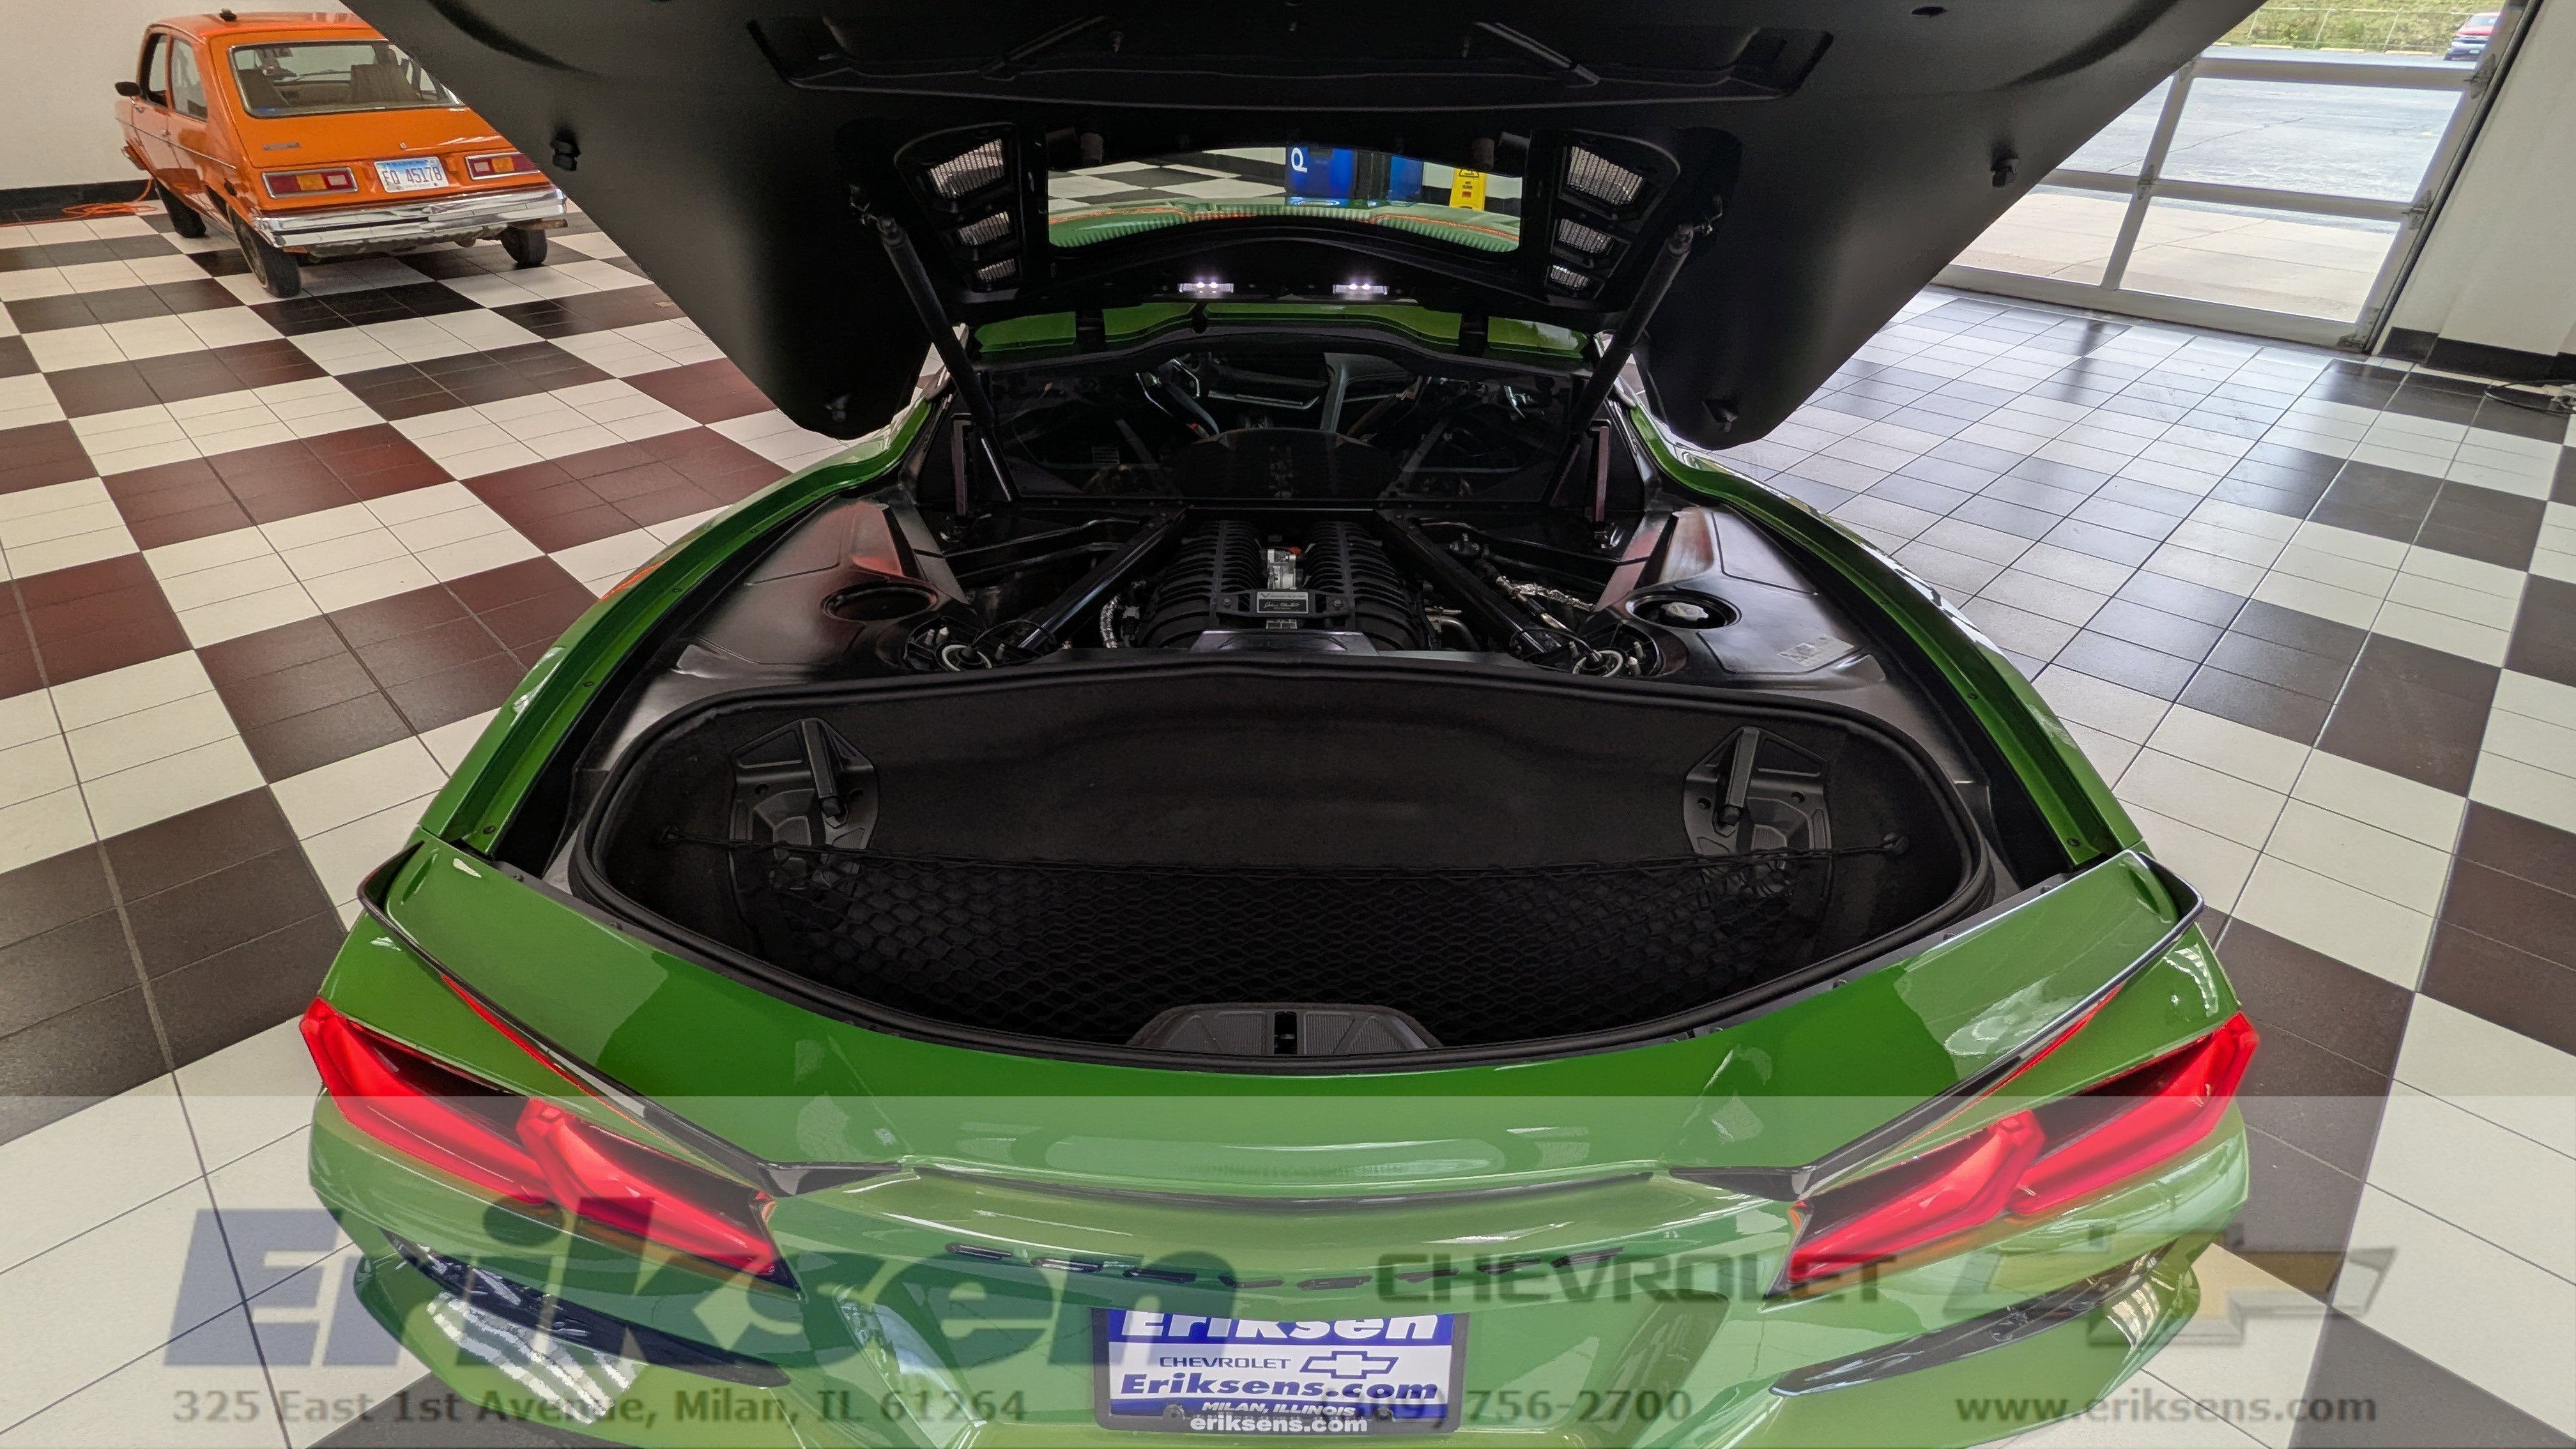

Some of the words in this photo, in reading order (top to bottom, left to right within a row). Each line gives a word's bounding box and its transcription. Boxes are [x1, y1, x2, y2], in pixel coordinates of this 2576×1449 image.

[1160, 1356, 1291, 1369] CHEVROLET
[1121, 1372, 1438, 1399] Eriksens.com
[1202, 1402, 1269, 1414] MILAN,
[1273, 1404, 1356, 1416] ILLINOIS
[1190, 1414, 1368, 1432] eriksens.com
